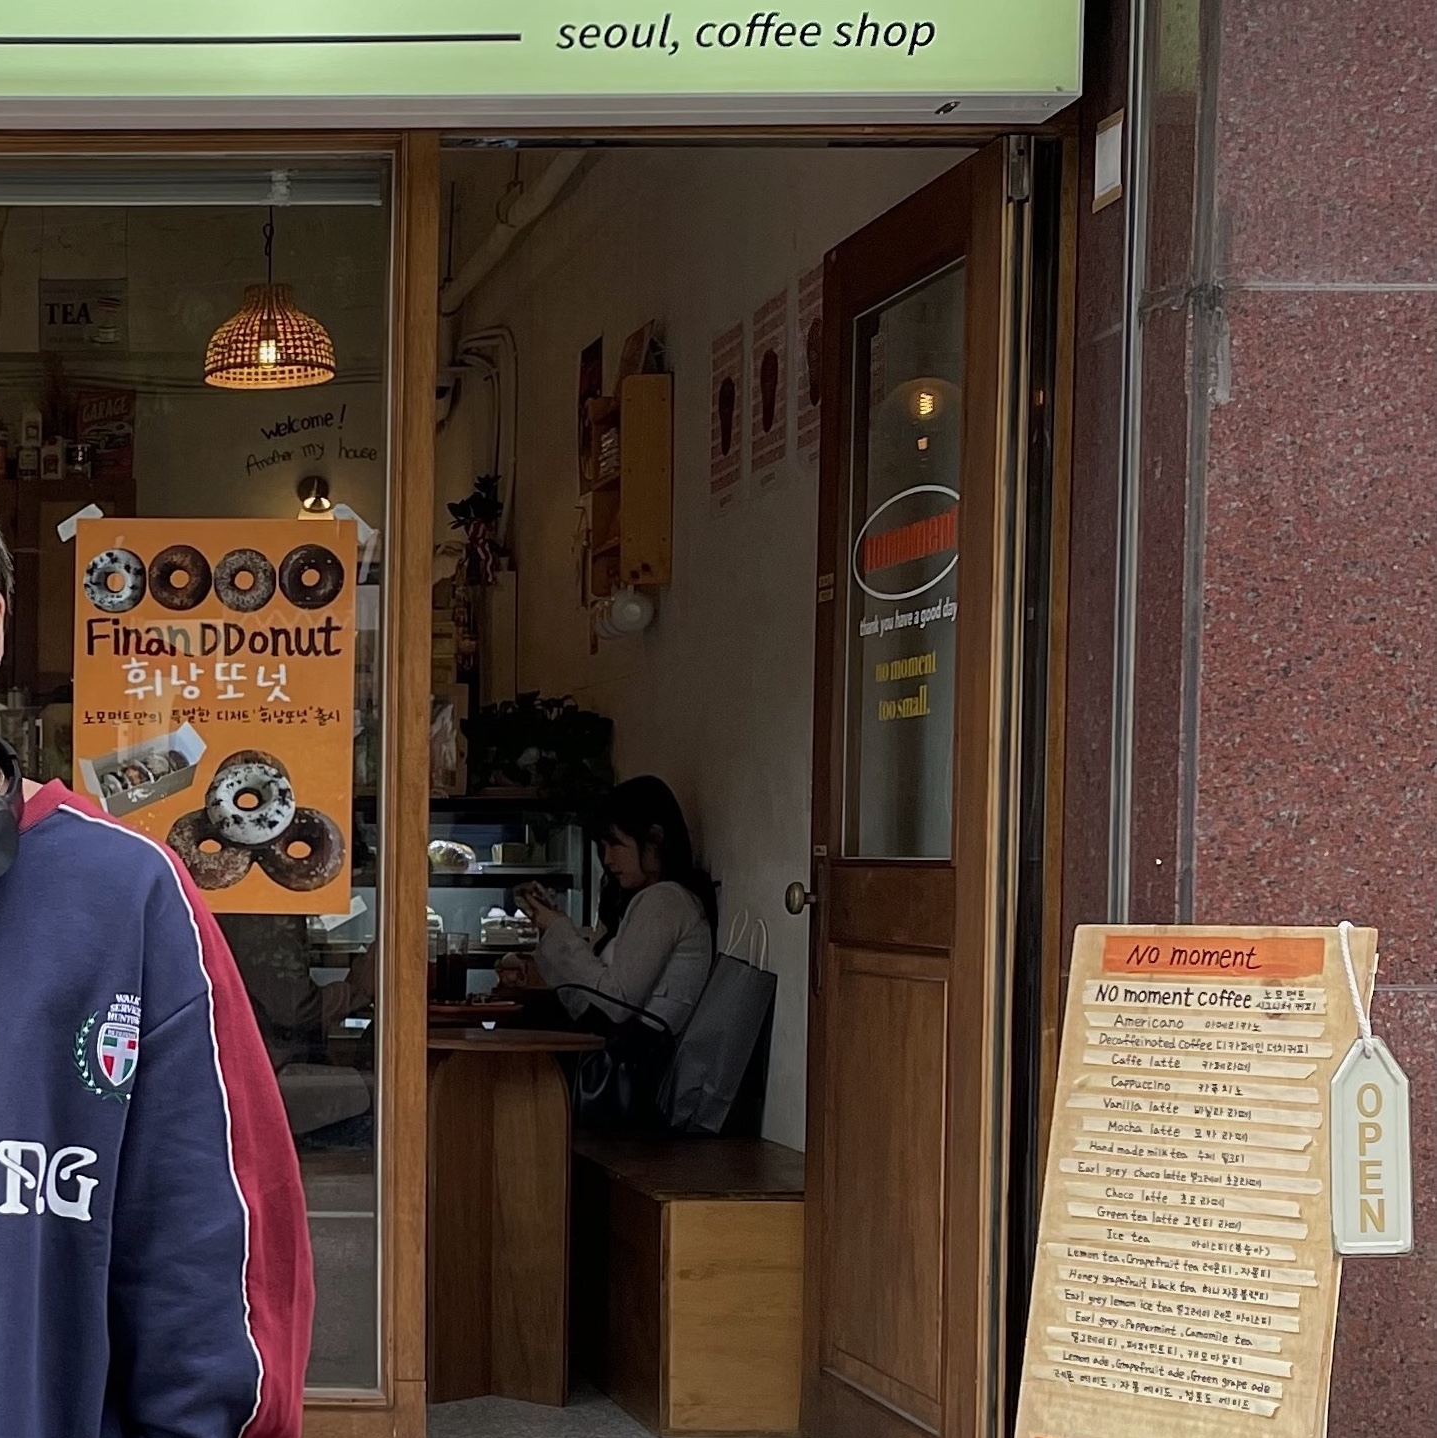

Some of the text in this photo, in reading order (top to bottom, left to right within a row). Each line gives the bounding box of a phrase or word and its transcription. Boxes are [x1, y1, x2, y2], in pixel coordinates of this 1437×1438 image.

[556, 11, 936, 57] seoul, coffee shop
[44, 302, 93, 325] TEA
[82, 396, 129, 423] GARAGE
[301, 443, 325, 461] my
[338, 436, 377, 461] house
[859, 596, 959, 637] thank you have a good day
[875, 649, 938, 682] no moment
[878, 684, 931, 721] too small.
[170, 706, 210, 724] 특별한
[216, 710, 251, 723] 디저트
[314, 708, 341, 726] 출시
[1170, 946, 1263, 970] moment
[1094, 983, 1252, 1009] NO moment coffee
[1295, 1002, 1316, 1011] 커피
[1114, 1013, 1262, 1032] Americano 아메리카노
[1099, 1033, 1176, 1050] Decaffeinated
[1178, 1036, 1213, 1051] coffee
[1216, 1040, 1264, 1054] 디카페인
[1111, 1053, 1251, 1073] Caffe latte 카페라떼
[1110, 1075, 1244, 1096] Cappuccino 카푸치노
[1103, 1097, 1252, 1121] Vanilla latte 바닐라 라떼
[1107, 1120, 1143, 1134] Mocha
[1149, 1124, 1181, 1138] latte
[1221, 1131, 1248, 1143] 라떼
[1088, 1139, 1114, 1153] Hand
[1116, 1143, 1144, 1157] made
[1146, 1145, 1168, 1158] milk
[1169, 1147, 1188, 1160] tea
[1356, 1082, 1386, 1234] OPEN
[1077, 1161, 1100, 1174] Earl
[1105, 1167, 1127, 1179] grey
[1163, 1169, 1187, 1182] latte
[1105, 1187, 1134, 1200] Choco
[1141, 1189, 1168, 1204] latte
[1199, 1196, 1225, 1208] 라떼
[1097, 1206, 1242, 1232] Green tea latte 그린티 라떼
[1106, 1228, 1124, 1241] Ice
[1131, 1230, 1150, 1243] tea
[1067, 1246, 1099, 1260] Lemon
[1183, 1259, 1199, 1272] tea
[1068, 1268, 1098, 1284] Honey
[1102, 1274, 1146, 1291] grapefruit
[1151, 1278, 1175, 1292] black
[1179, 1280, 1197, 1293] tea
[1064, 1288, 1084, 1301] Earl
[1088, 1294, 1107, 1307] grey
[1110, 1292, 1136, 1307] lemon
[1139, 1298, 1153, 1310] ice
[1157, 1300, 1173, 1312] tea
[1236, 1313, 1272, 1326] 아이스티
[1075, 1311, 1094, 1324] Earl
[1234, 1334, 1253, 1347] tea
[1063, 1350, 1090, 1364] Lemon
[1115, 1359, 1165, 1377] Grapefruit
[1190, 1370, 1218, 1385] Green
[1221, 1375, 1248, 1391] grape
[1251, 1381, 1271, 1394] ade
[1218, 1396, 1250, 1410] 에이드
